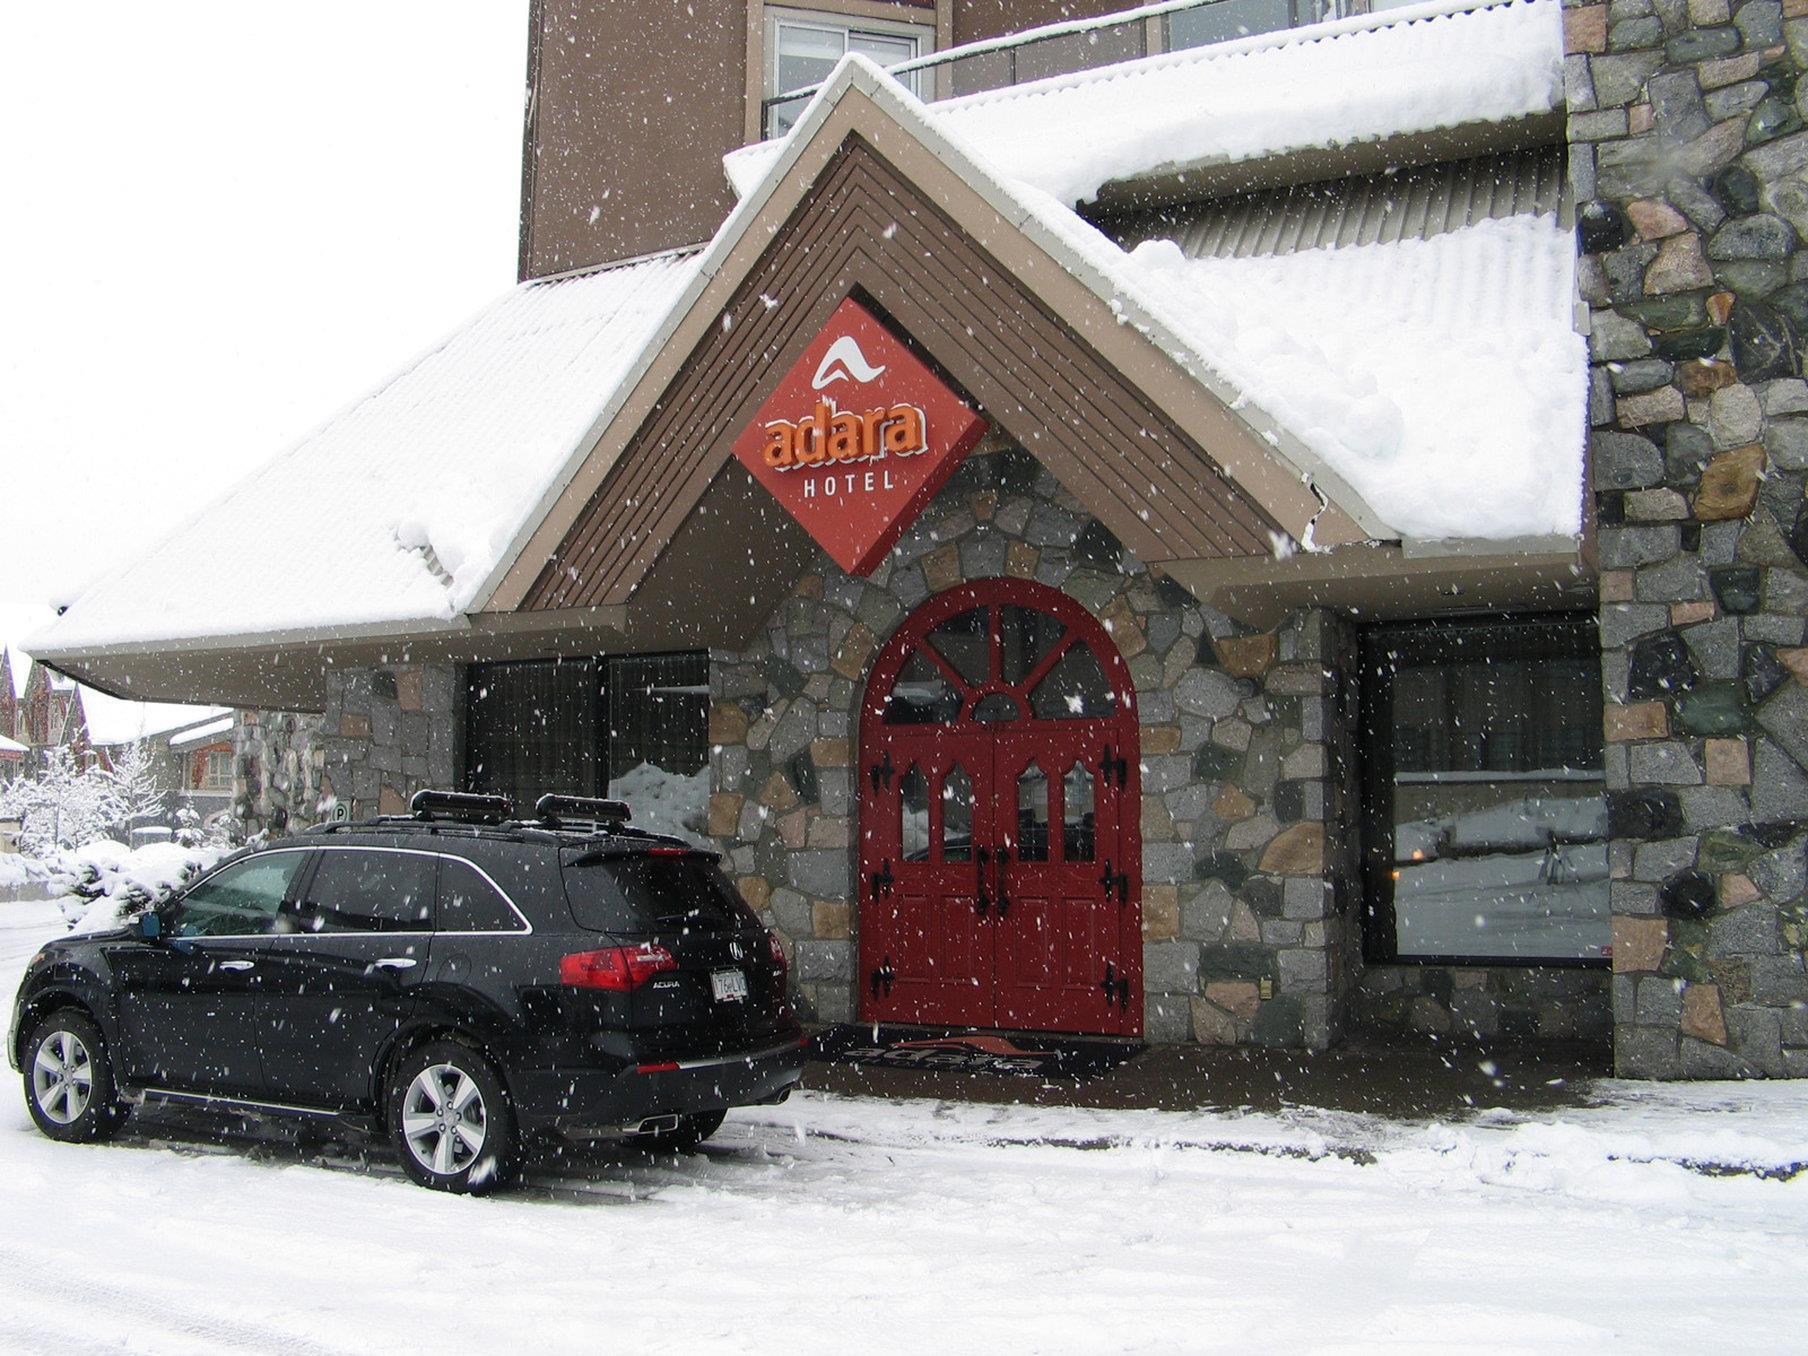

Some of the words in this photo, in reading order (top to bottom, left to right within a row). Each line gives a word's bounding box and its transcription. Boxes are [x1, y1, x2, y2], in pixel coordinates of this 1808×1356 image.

[764, 400, 926, 470] adara
[804, 470, 894, 498] HOTEL
[652, 980, 681, 989] ACURA
